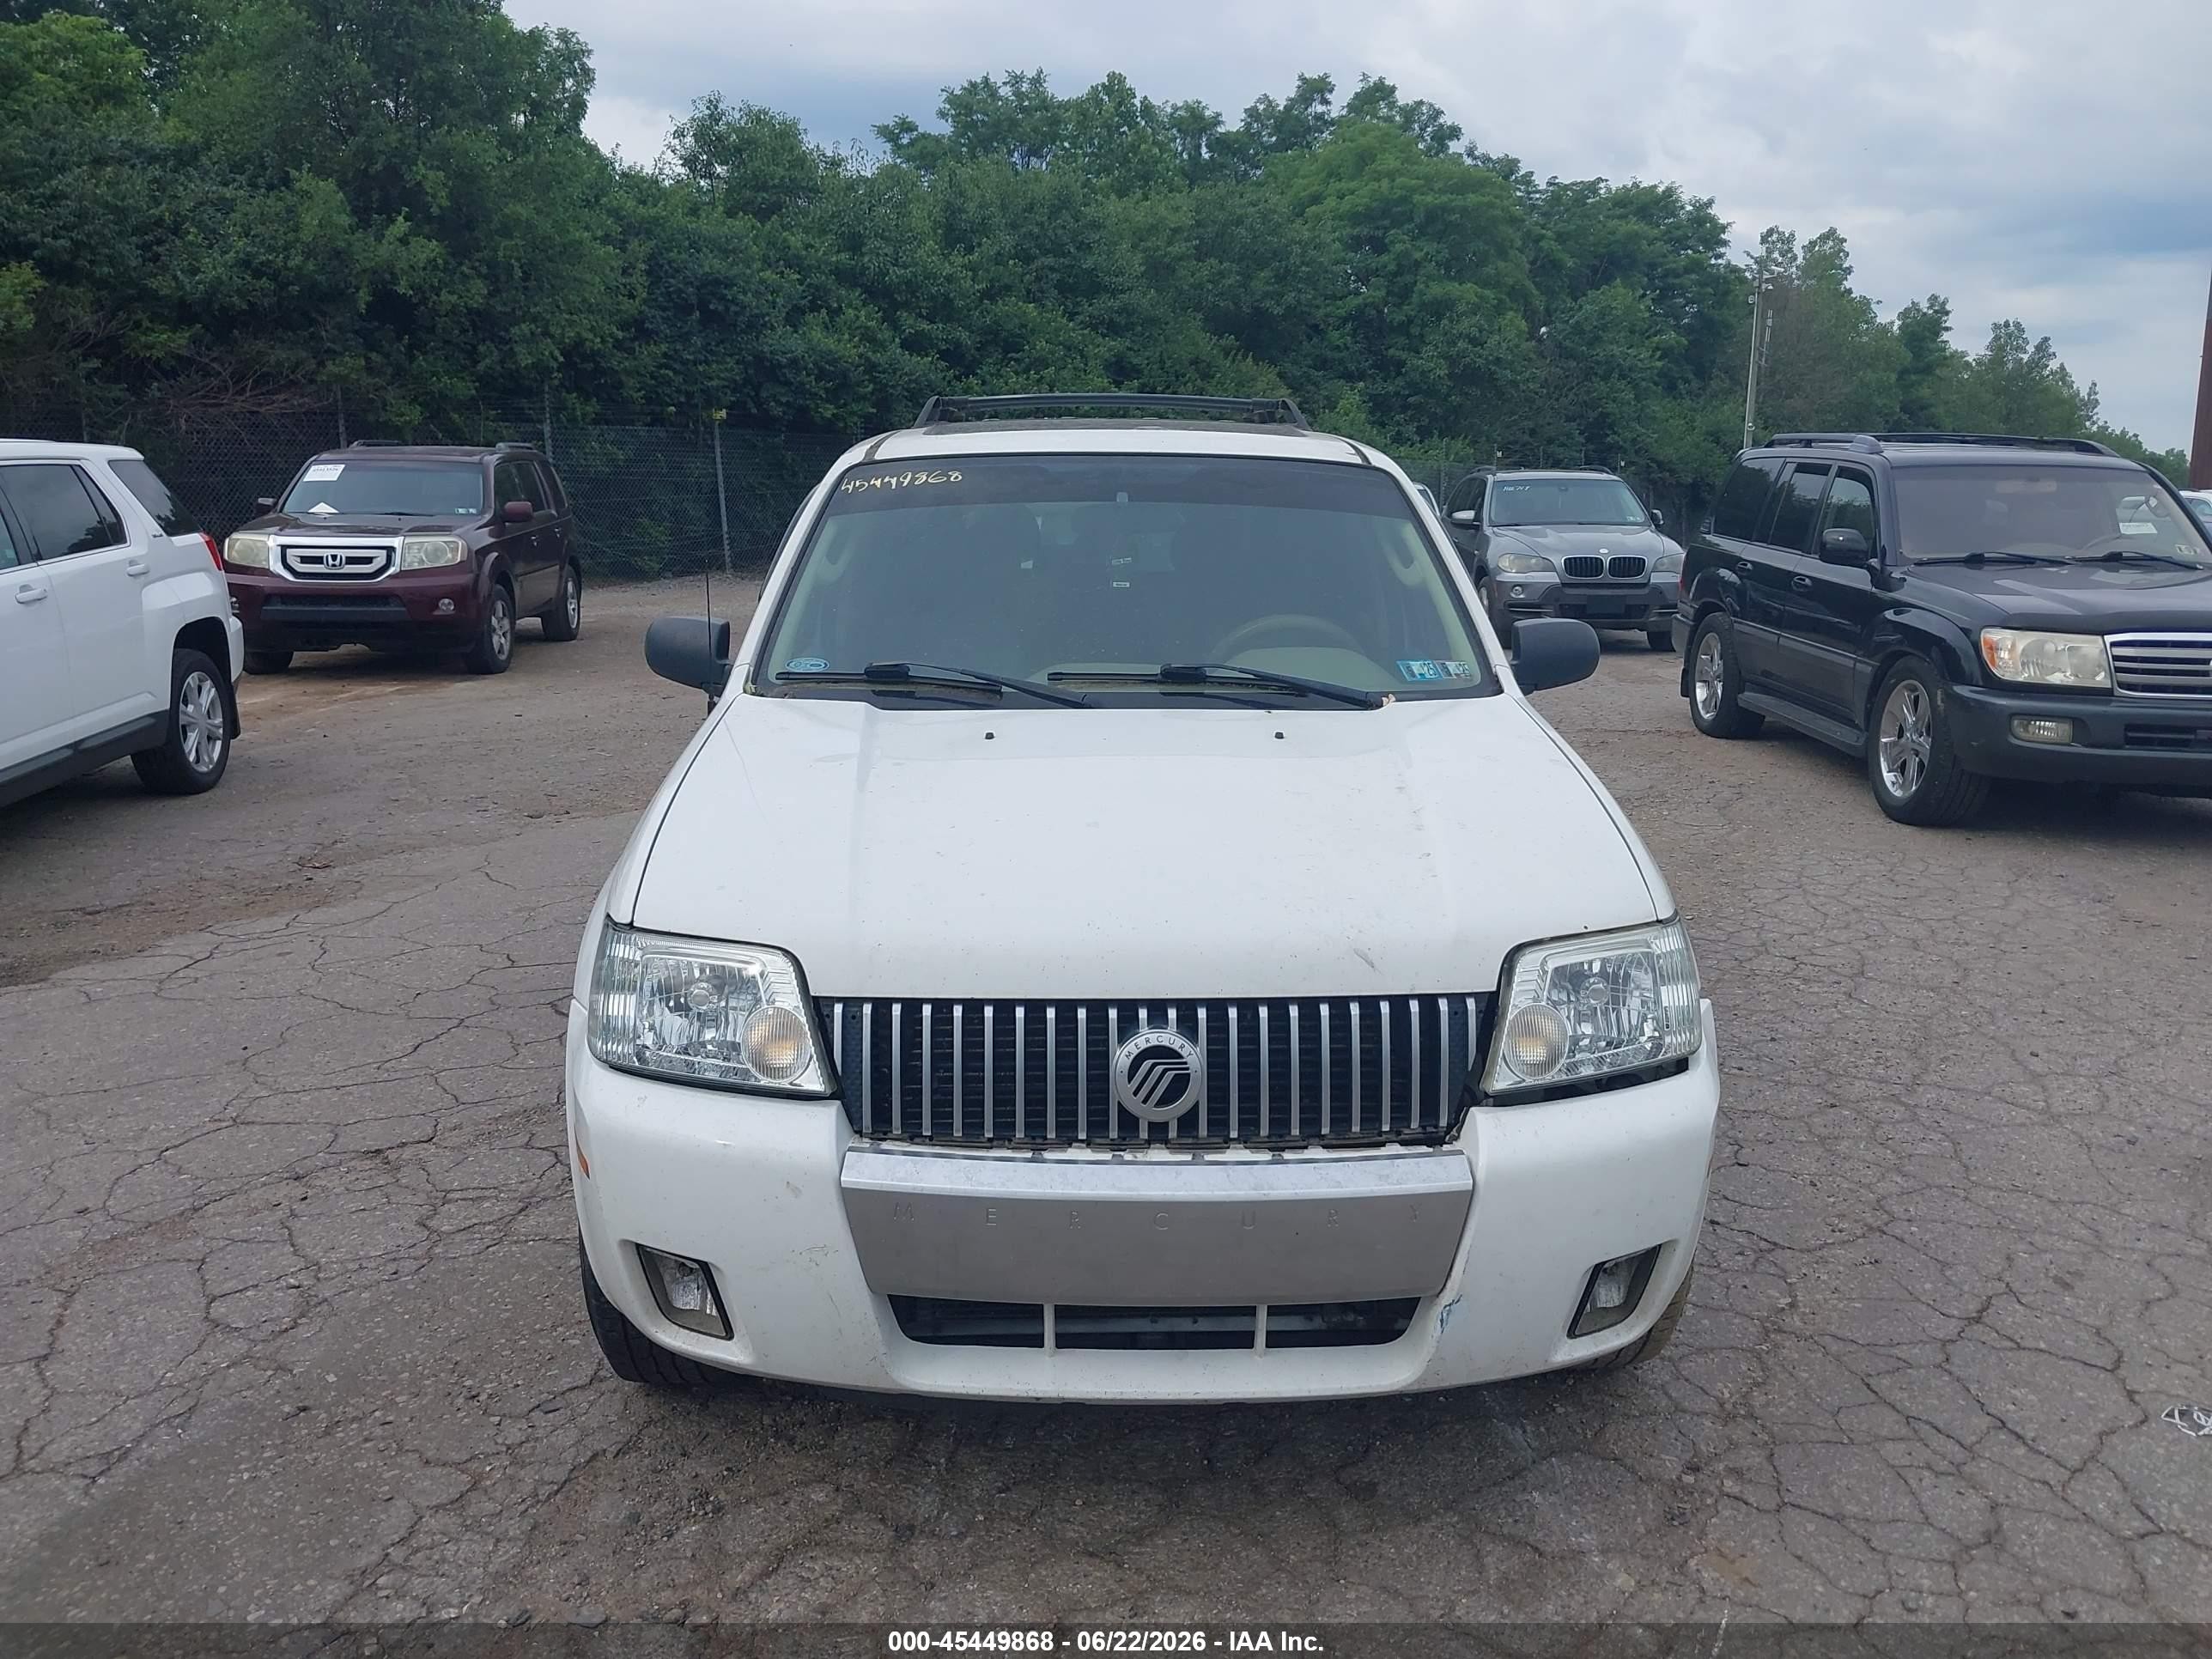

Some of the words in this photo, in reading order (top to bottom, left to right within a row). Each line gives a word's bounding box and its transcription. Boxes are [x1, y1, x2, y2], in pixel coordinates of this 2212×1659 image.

[841, 470, 963, 494] 45449868
[1125, 1035, 1194, 1060] MERCURY
[893, 1201, 1422, 1230] MERCURY
